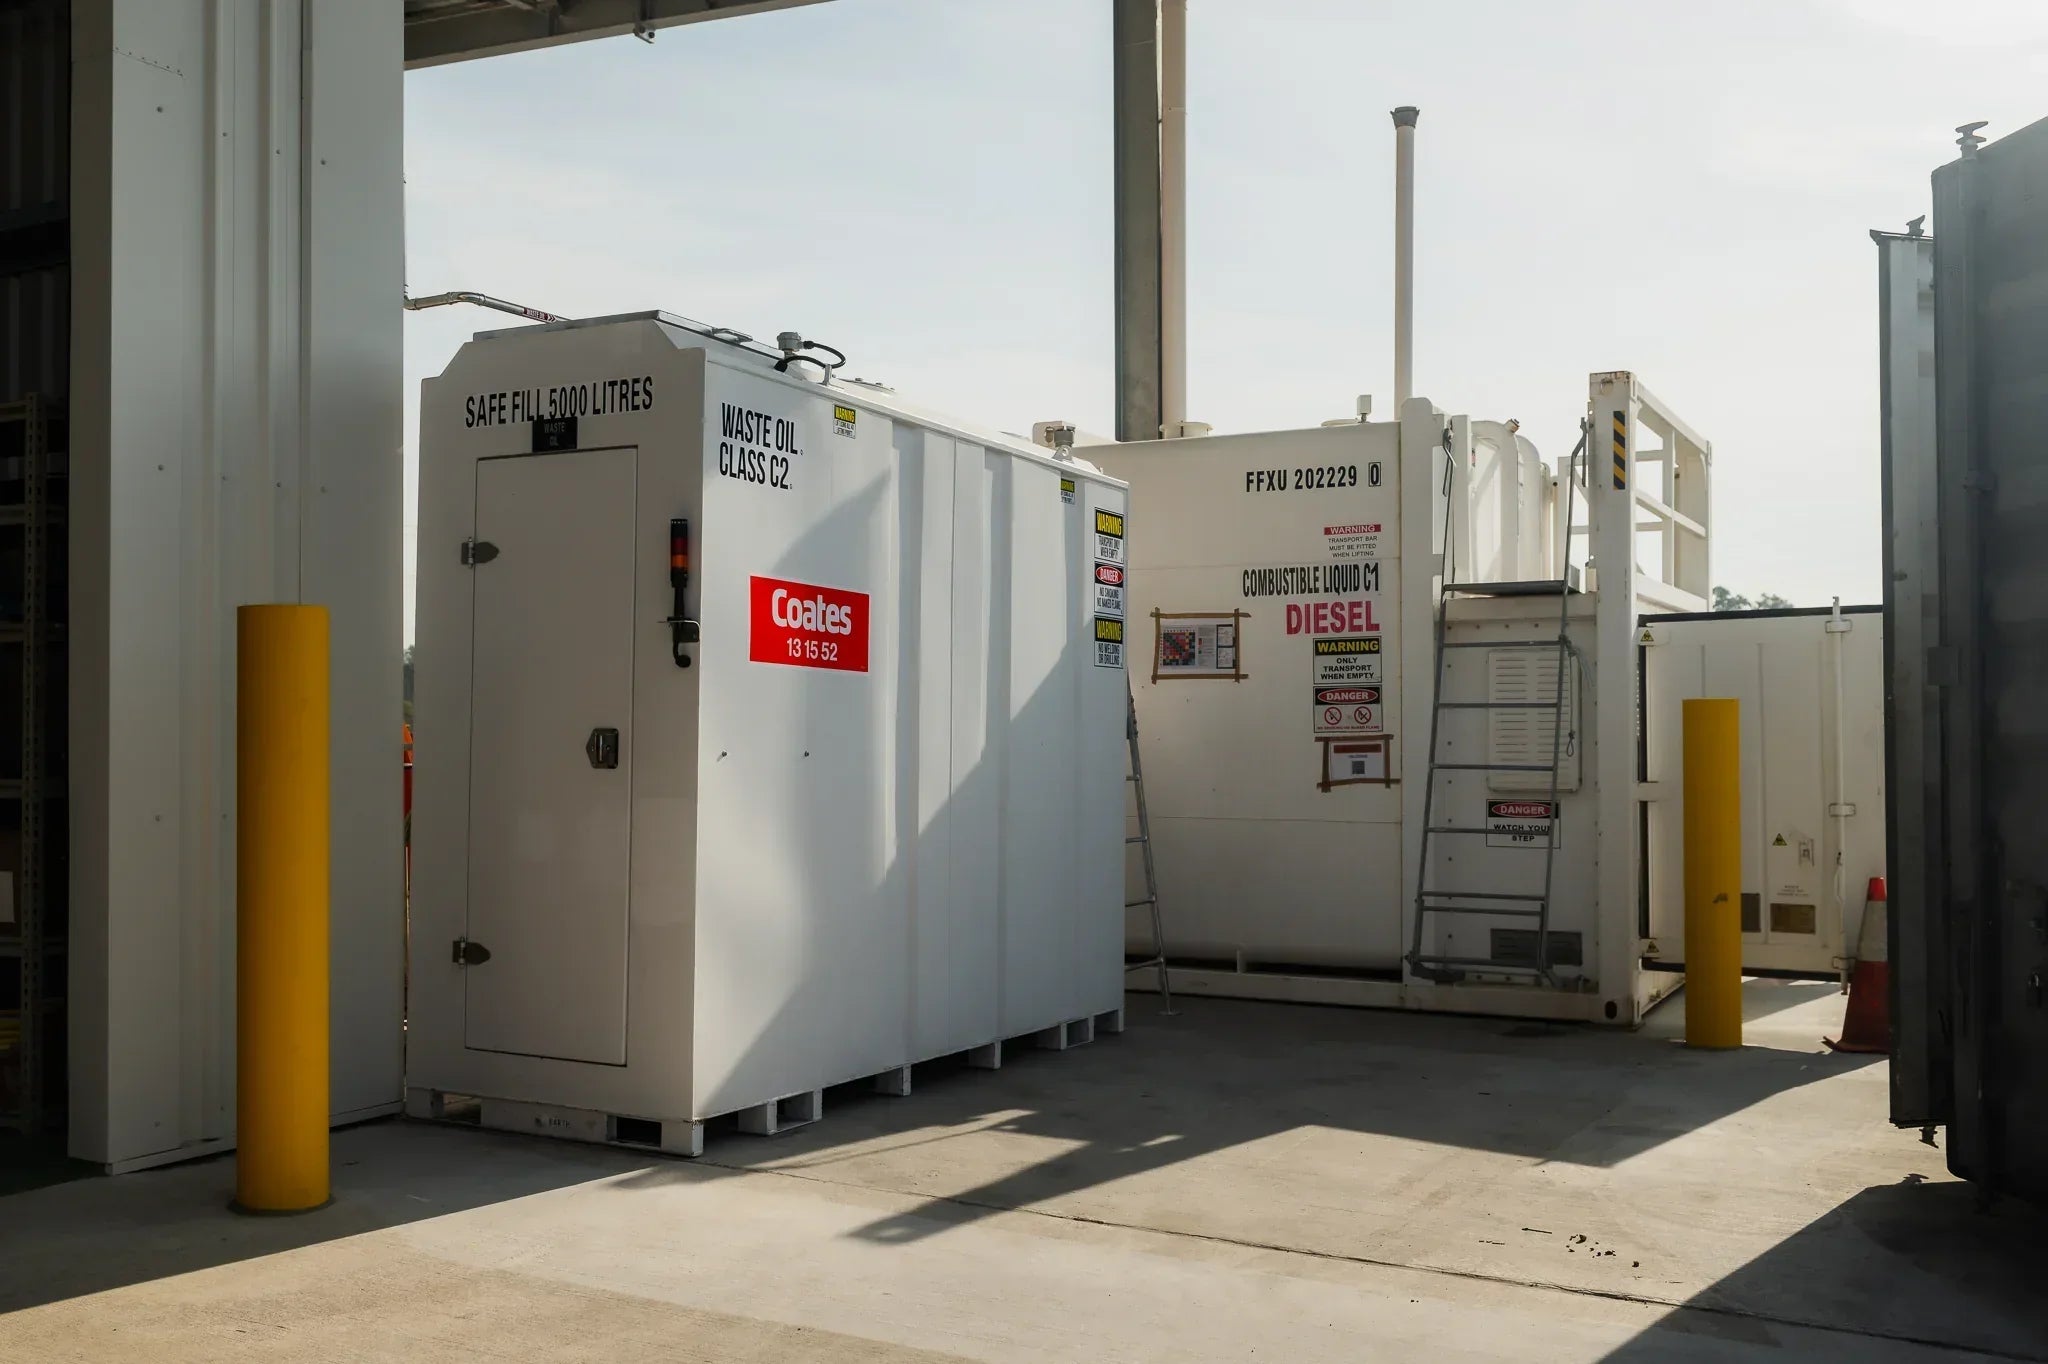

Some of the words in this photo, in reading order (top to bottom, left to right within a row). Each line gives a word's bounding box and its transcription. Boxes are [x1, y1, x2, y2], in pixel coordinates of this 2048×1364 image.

[465, 392, 507, 428] SAFE
[512, 388, 544, 423] FILL
[550, 385, 588, 419] 5000
[593, 376, 653, 415] LITRES
[544, 422, 566, 433] WASTE
[722, 402, 772, 448] WASTE
[776, 418, 798, 454] OIL
[720, 442, 765, 484] CLASS
[770, 455, 788, 490] C2
[1246, 469, 1287, 492] FFXU
[1295, 465, 1357, 490] 202229
[1097, 512, 1121, 536] WARNING
[1330, 526, 1375, 534] WARNING
[1100, 567, 1118, 582] DANGER
[1243, 566, 1319, 597] COMBUSTIBLE
[1324, 564, 1360, 595] LIQUID
[1364, 562, 1379, 592] C1
[772, 588, 852, 635] Coates
[1286, 600, 1380, 635] DIESEL
[1097, 620, 1121, 641] WARNING
[787, 638, 801, 658] 13
[804, 640, 818, 660] 15
[821, 642, 838, 661] 52
[1318, 641, 1379, 652] WARNING
[1327, 692, 1368, 700] DANGER
[1500, 806, 1544, 814] DANGER
